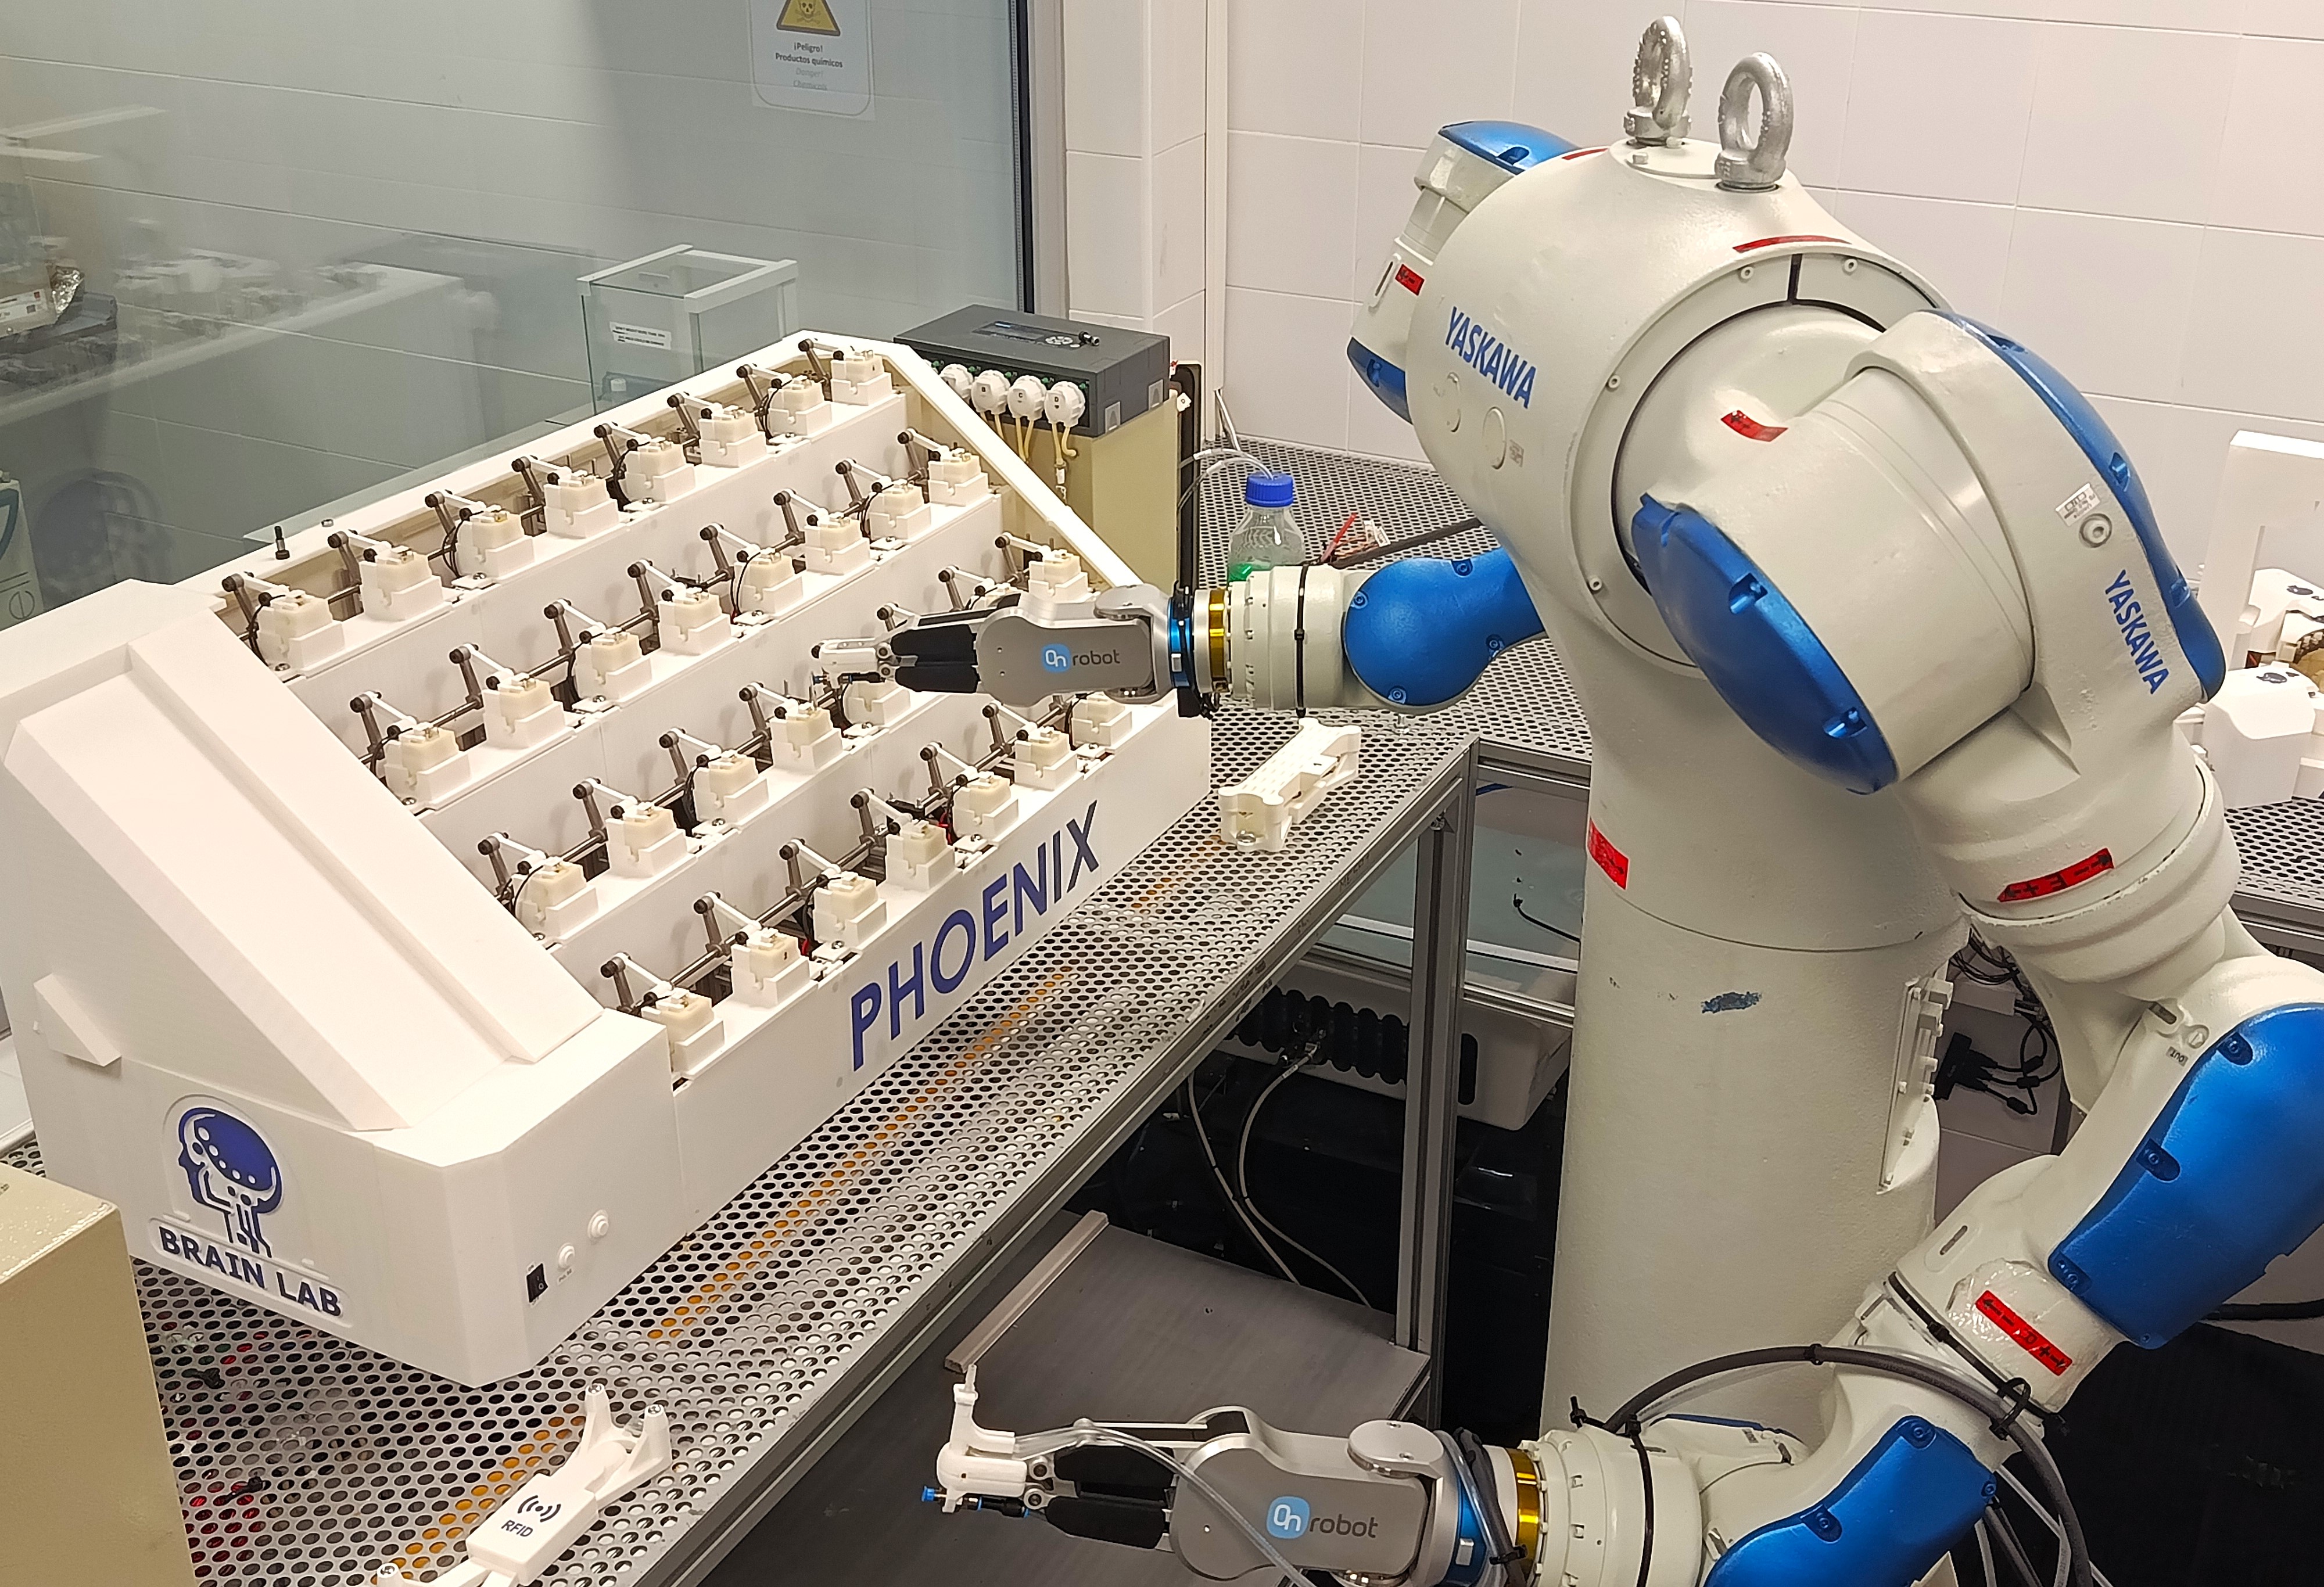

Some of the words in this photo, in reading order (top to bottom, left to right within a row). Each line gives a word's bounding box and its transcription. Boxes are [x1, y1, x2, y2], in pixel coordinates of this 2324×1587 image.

[794, 42, 823, 53] ¡Peligro!
[775, 52, 810, 64] Productos
[812, 56, 843, 68] químicos
[1444, 305, 1537, 410] YASKAWA
[2104, 569, 2170, 695] YASKAWA
[1073, 649, 1120, 666] robot
[851, 800, 1099, 1071] PHOENIX
[2169, 1050, 2185, 1062] OUT
[159, 1226, 265, 1289] BRAIN
[276, 1272, 342, 1316] LAB
[501, 1520, 533, 1537] RFID
[1310, 1514, 1378, 1538] robot
